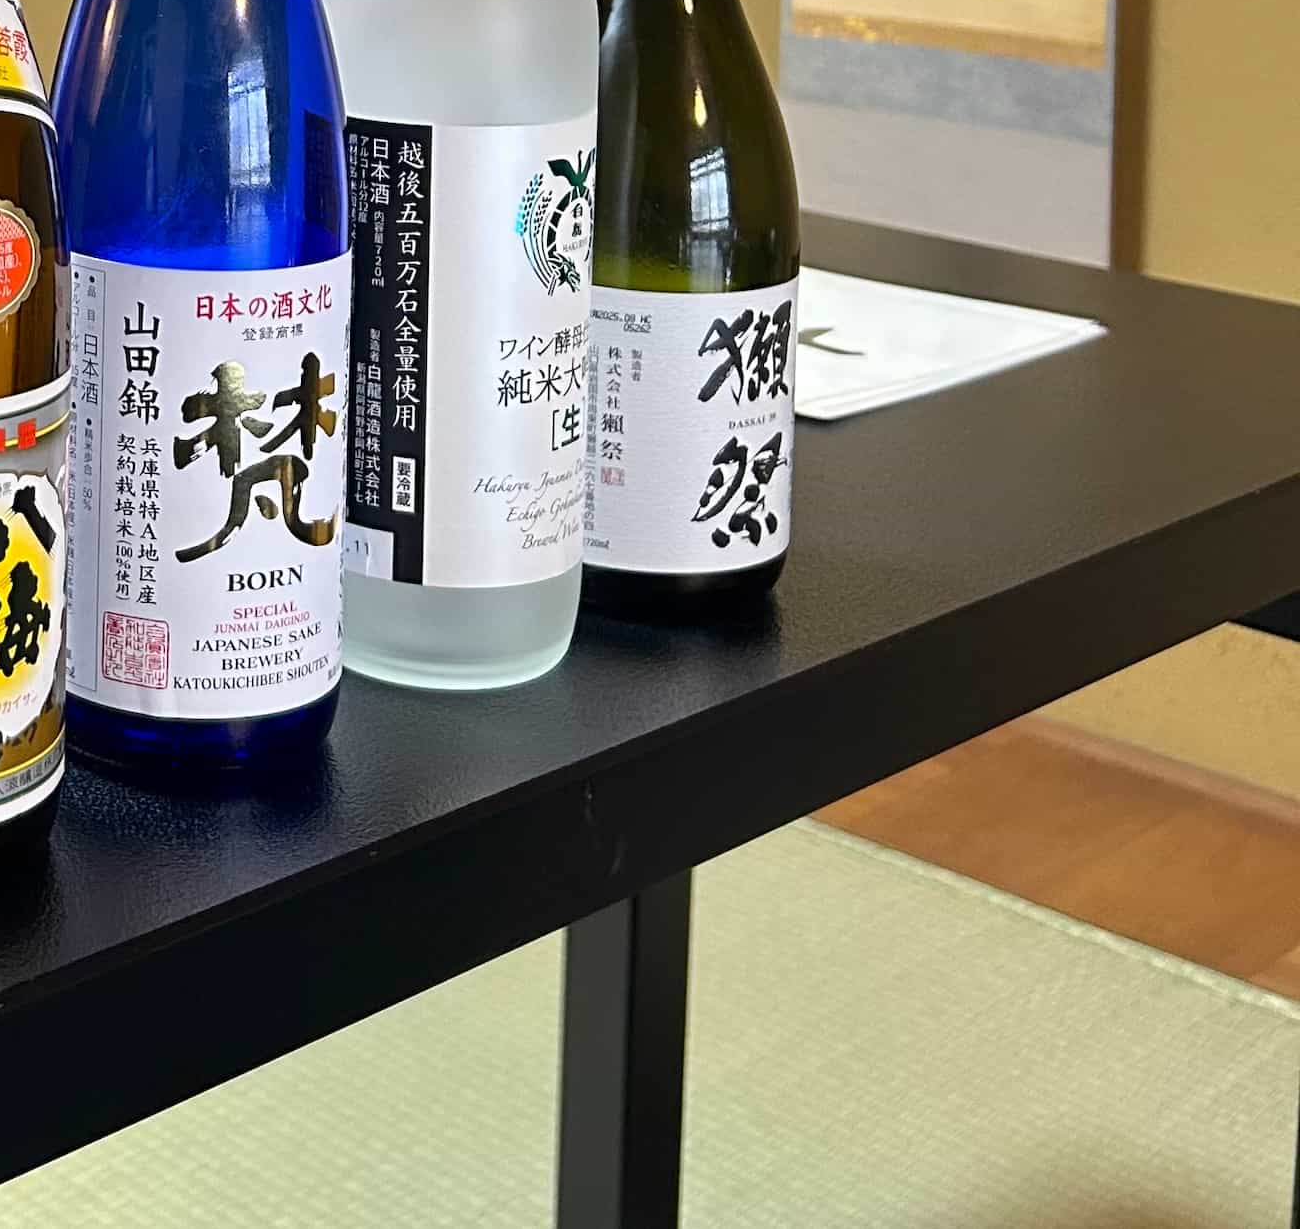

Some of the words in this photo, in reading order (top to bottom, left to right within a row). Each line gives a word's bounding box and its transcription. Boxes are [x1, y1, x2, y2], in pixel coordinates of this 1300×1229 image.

[370, 138, 390, 205] 日本酒
[196, 284, 333, 323] 日本の酒文化
[392, 140, 426, 432] 越後五百万石全量使用
[499, 320, 588, 361] ワイン酵母
[81, 333, 99, 406] 日本酒
[118, 300, 161, 426] 山田錦
[600, 345, 625, 461] 株式会社獺祭
[728, 414, 766, 430] DASSAI
[173, 351, 339, 564] 梵
[396, 461, 412, 507] 要冷蔵
[137, 437, 162, 606] 兵庫県特A地区産
[227, 564, 305, 593] BORN
[213, 622, 260, 635] JUNMAI
[265, 611, 311, 631] DAIGINJO
[233, 601, 298, 620] SPECIAL
[192, 633, 284, 652] JAPANESE
[288, 621, 323, 644] SAKE
[221, 648, 305, 671] BREWERY
[173, 670, 284, 691] KATOUKICHIBEE
